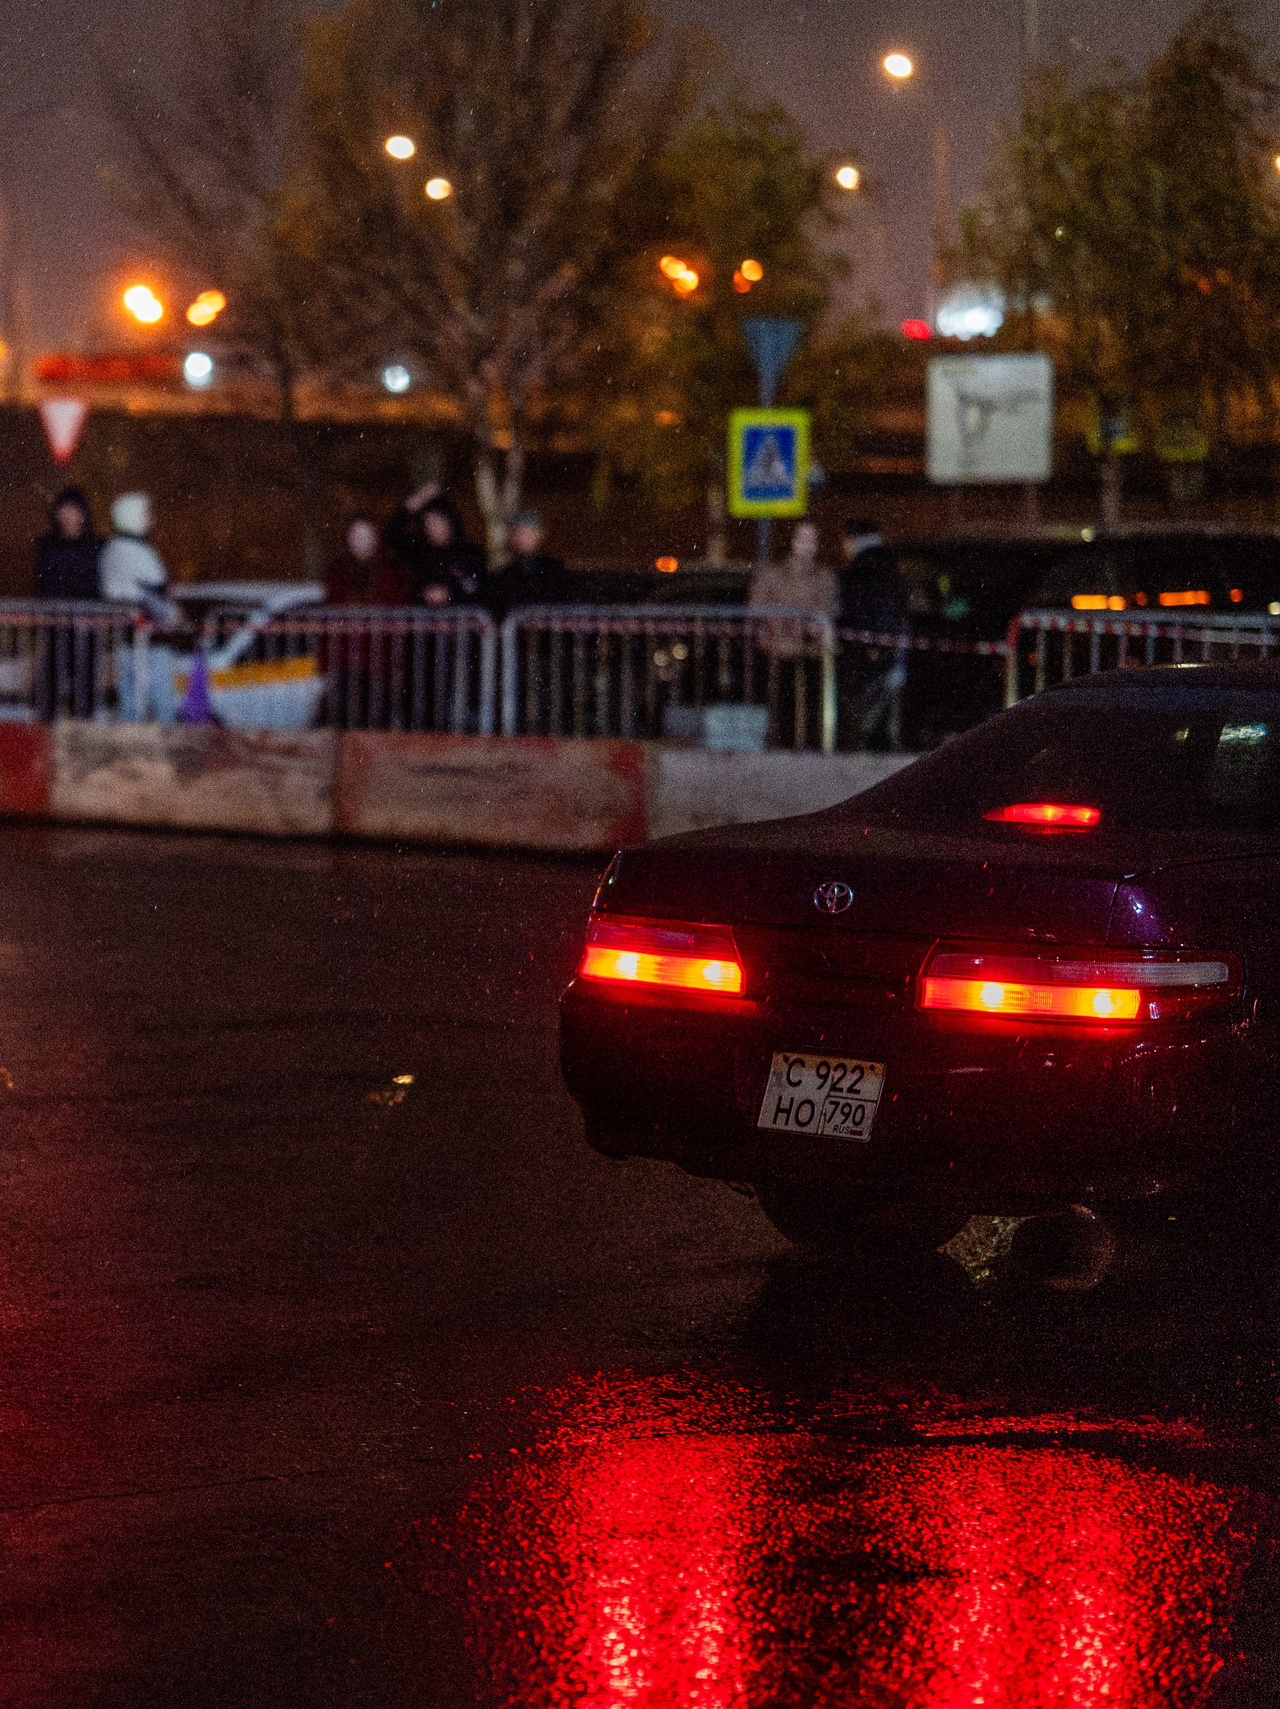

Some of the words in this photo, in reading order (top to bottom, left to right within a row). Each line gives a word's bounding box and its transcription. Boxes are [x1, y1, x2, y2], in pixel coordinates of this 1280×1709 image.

[816, 1060, 865, 1095] 922
[827, 1101, 866, 1127] 790
[832, 1125, 851, 1134] RUS
